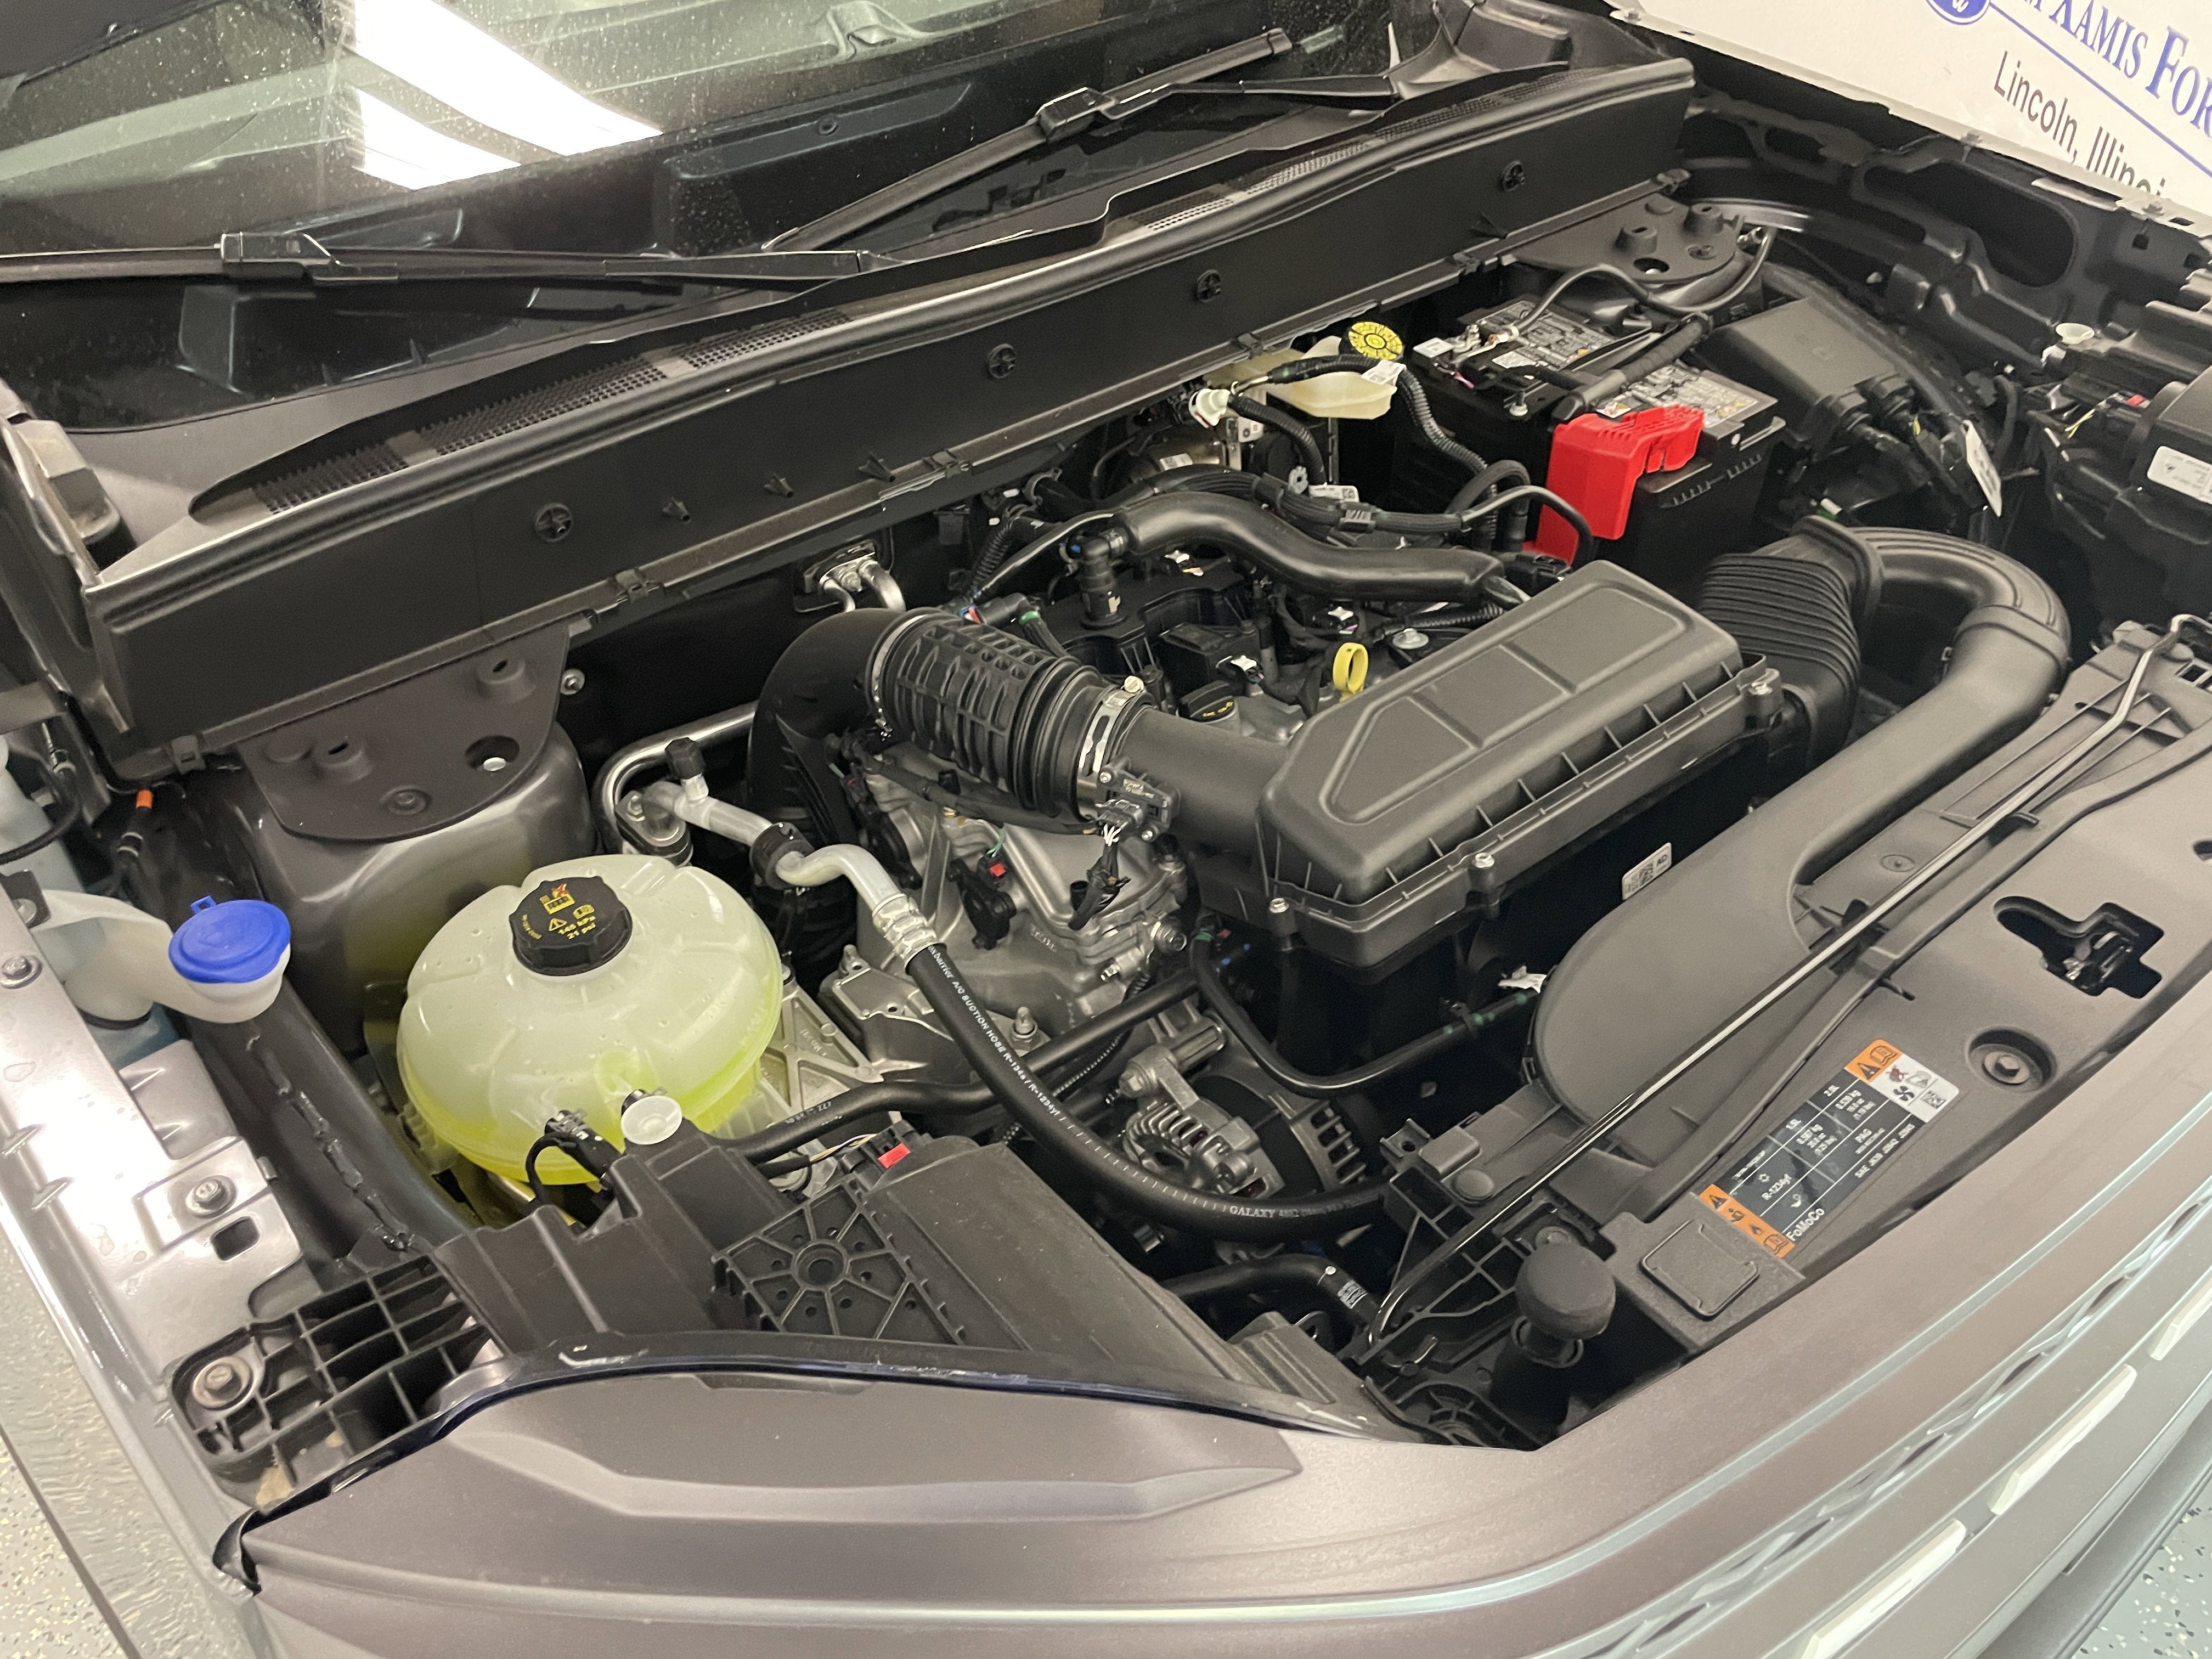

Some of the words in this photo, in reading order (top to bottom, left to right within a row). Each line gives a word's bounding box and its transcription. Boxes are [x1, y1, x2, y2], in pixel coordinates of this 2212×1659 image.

[1994, 50, 2077, 163] Lincoln,
[2145, 25, 2212, 138] FOR
[1786, 1208, 1825, 1242] FoMoCo
